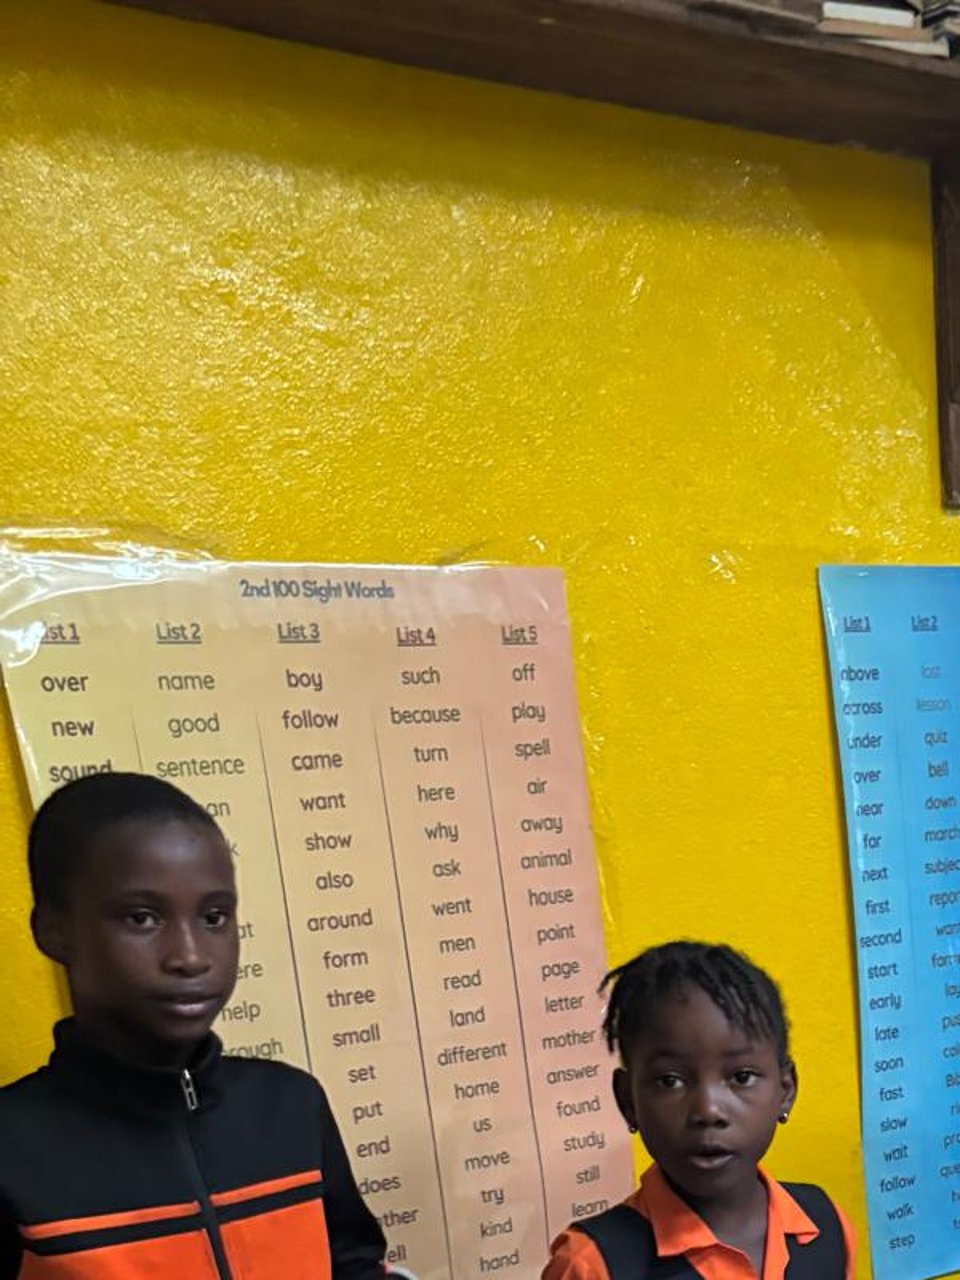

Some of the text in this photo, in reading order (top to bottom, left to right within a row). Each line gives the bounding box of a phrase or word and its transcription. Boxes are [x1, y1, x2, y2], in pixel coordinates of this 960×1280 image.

[240, 578, 395, 603] 2nd 100 Sight Words
[156, 622, 202, 643] List 2
[277, 622, 321, 643] List 3
[844, 616, 864, 632] List
[911, 616, 930, 631] List
[396, 626, 437, 646] List 4
[501, 625, 538, 645] List 5
[158, 672, 215, 690] name
[286, 669, 323, 692] boy
[401, 666, 440, 685] such
[512, 663, 536, 681] off
[841, 666, 880, 681] above
[41, 674, 89, 692] over
[390, 706, 461, 726] because
[511, 702, 546, 723] play
[843, 700, 883, 715] across
[51, 720, 94, 737] new
[168, 712, 221, 738] good
[282, 709, 339, 730] follow
[414, 746, 449, 762] turn
[514, 738, 551, 761] spell
[156, 754, 245, 778] sentence
[291, 751, 343, 770] came
[928, 760, 949, 778] bell
[854, 769, 881, 784] over
[417, 785, 456, 803] here
[527, 778, 548, 795] air
[300, 793, 346, 811] want
[857, 801, 884, 816] near
[425, 822, 459, 842] why
[520, 815, 563, 834] away
[305, 831, 352, 851] show
[432, 858, 462, 877] ask
[520, 849, 572, 870] animal
[315, 871, 354, 890] also
[862, 866, 889, 882] next
[528, 888, 574, 907] house
[866, 899, 890, 915] first
[432, 898, 473, 917] went
[307, 908, 374, 932] around
[537, 924, 576, 946] point
[860, 929, 903, 948] second
[439, 936, 476, 954] men
[323, 950, 369, 969] form
[541, 958, 581, 981] page
[868, 962, 898, 979] start
[443, 969, 482, 991] read
[326, 988, 376, 1009] three
[544, 994, 585, 1014] letter
[869, 993, 902, 1010] early
[449, 1006, 486, 1027] land
[332, 1024, 380, 1047] small
[542, 1029, 596, 1050] mother
[875, 1026, 899, 1041] late
[437, 1042, 507, 1066] different
[348, 1064, 376, 1083] set
[546, 1063, 600, 1085] answer
[874, 1056, 904, 1073] soon
[454, 1080, 500, 1100] home
[879, 1086, 905, 1102] fast
[352, 1102, 383, 1124] put
[556, 1096, 600, 1118] found
[473, 1117, 492, 1133] us
[880, 1116, 909, 1133] slow
[356, 1135, 391, 1158] end
[563, 1130, 605, 1152] study
[465, 1150, 511, 1170] move
[883, 1144, 909, 1163] wait
[575, 1166, 600, 1185] still
[880, 1175, 916, 1194] follow
[358, 1176, 402, 1196] does
[480, 1187, 505, 1205] try
[571, 1198, 609, 1218] learn
[886, 1202, 915, 1222] walk
[480, 1218, 513, 1239] kind
[889, 1233, 916, 1250] step
[480, 1250, 520, 1273] hand
